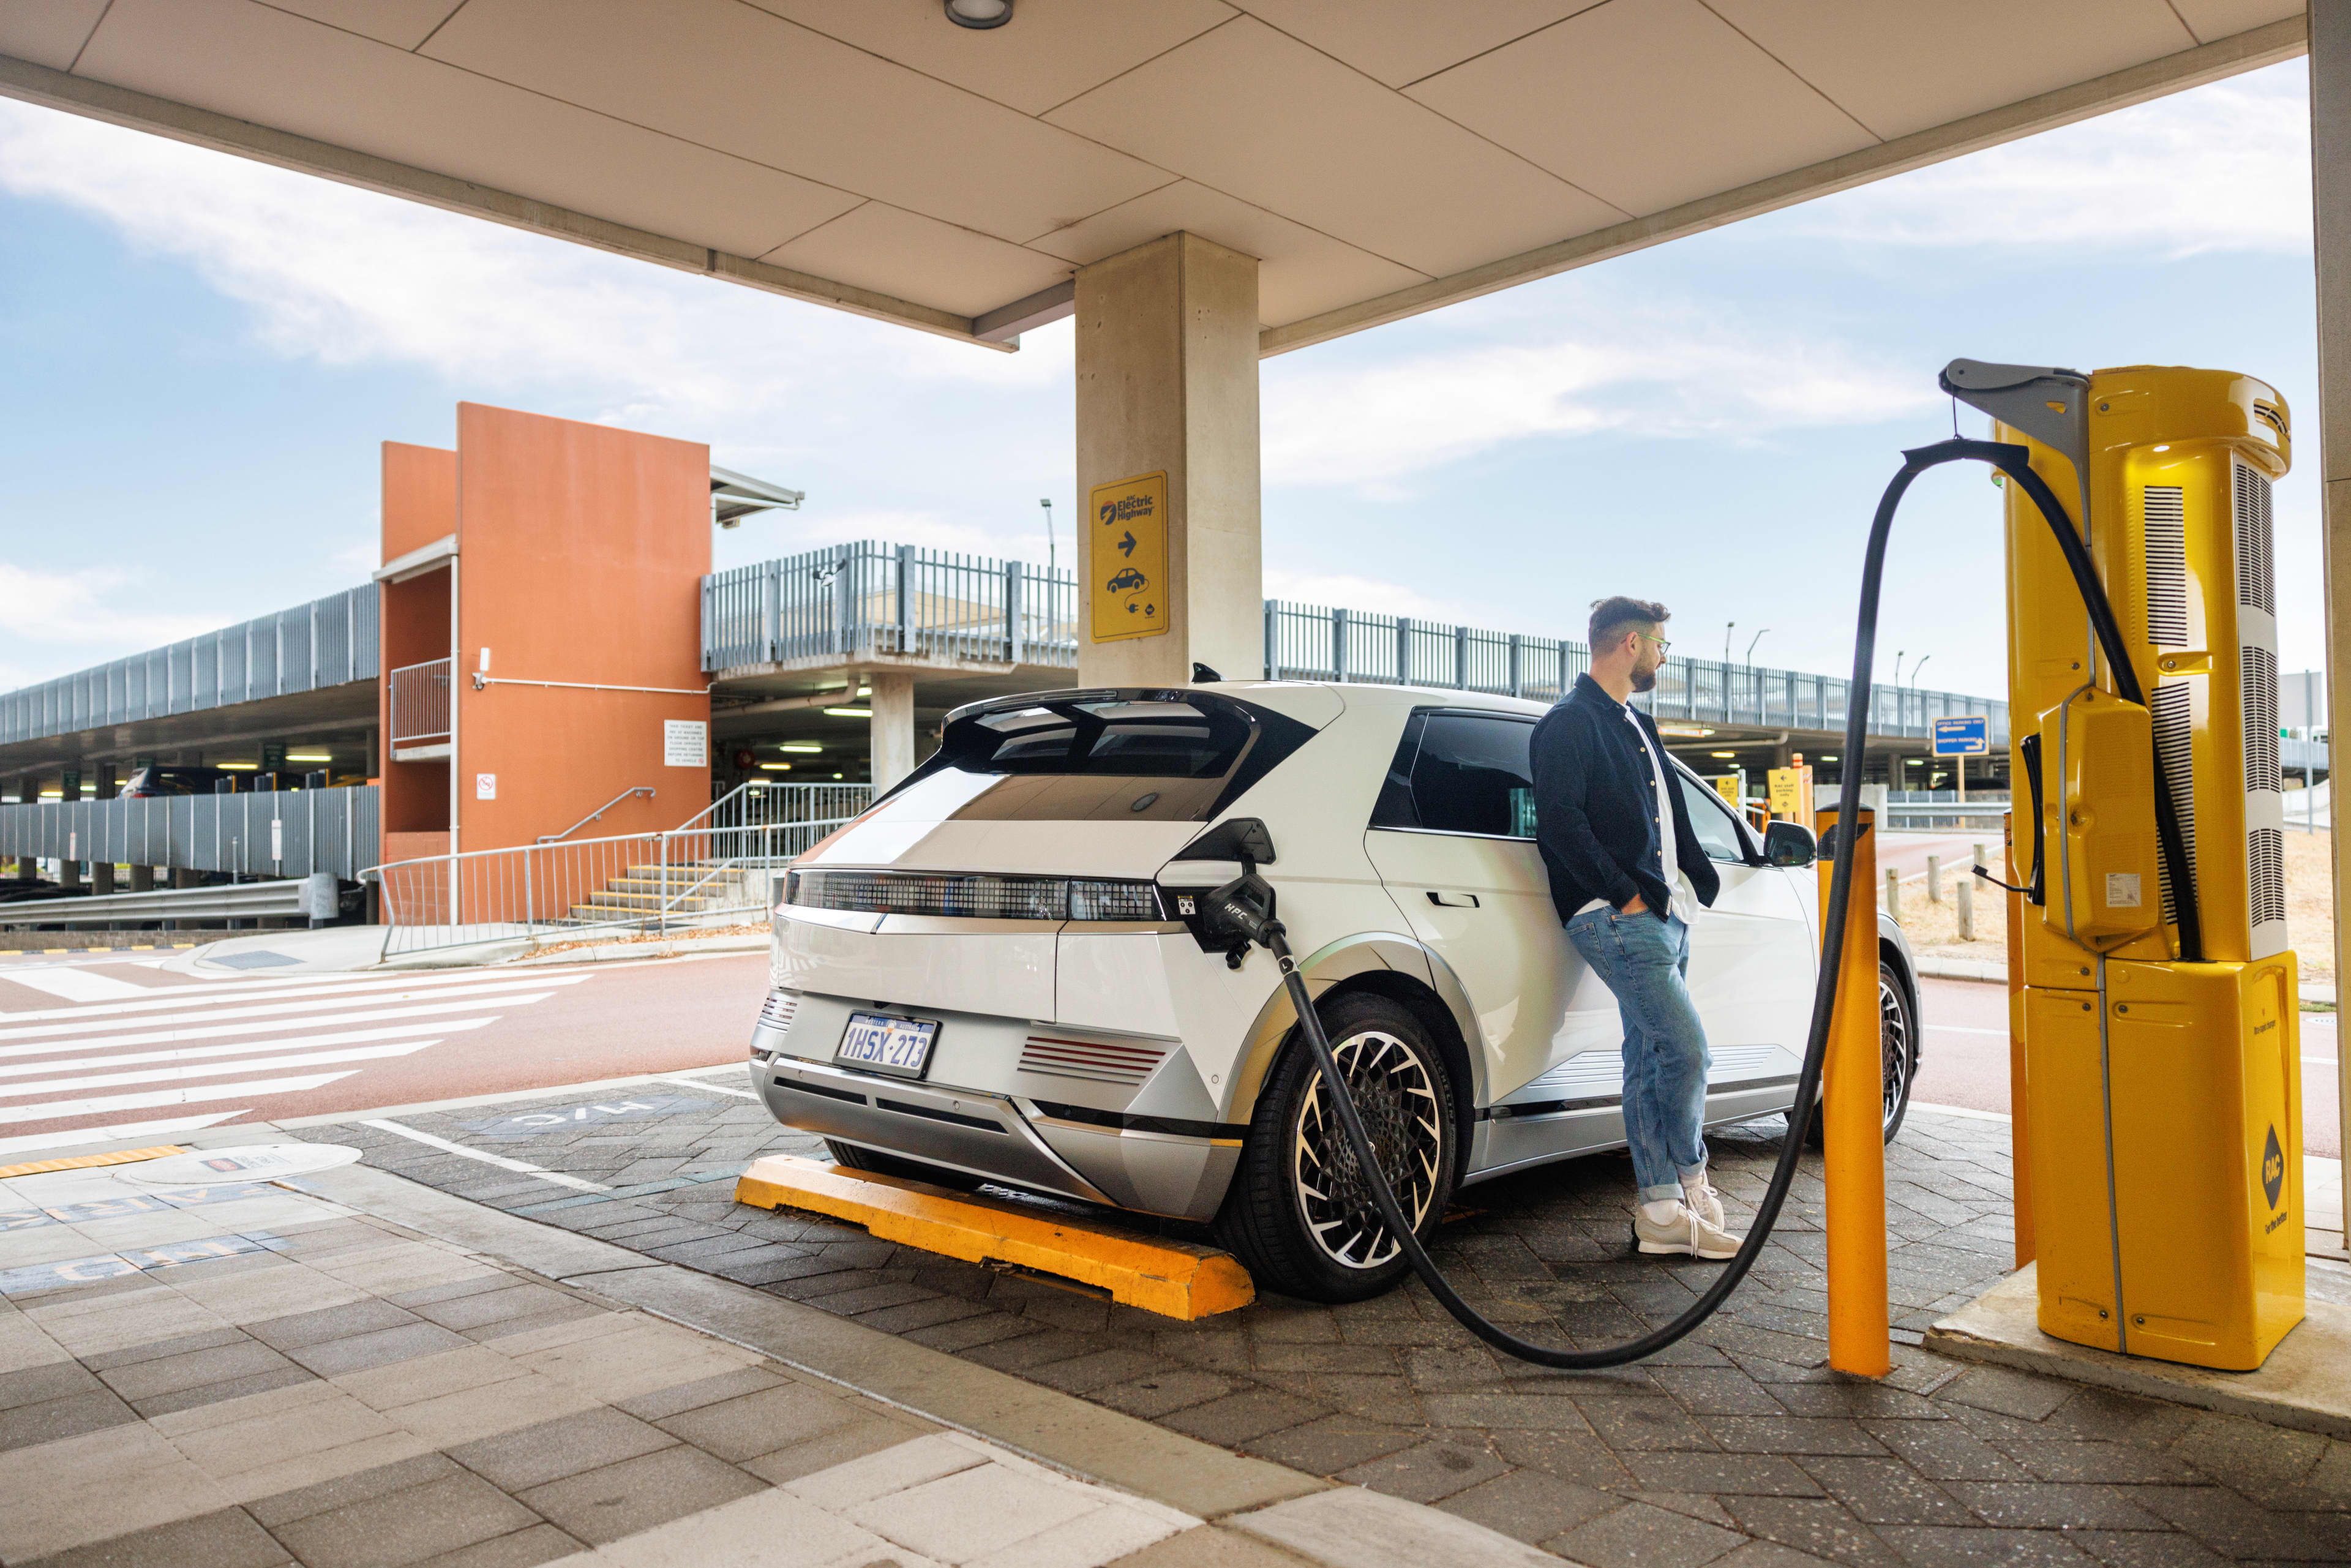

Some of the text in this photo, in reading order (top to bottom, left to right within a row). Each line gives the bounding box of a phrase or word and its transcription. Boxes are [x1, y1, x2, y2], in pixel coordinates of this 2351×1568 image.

[1117, 495, 1153, 511] Electric
[1117, 506, 1155, 521] Highway
[1224, 903, 1247, 920] HPC
[2265, 1154, 2280, 1184] RAC
